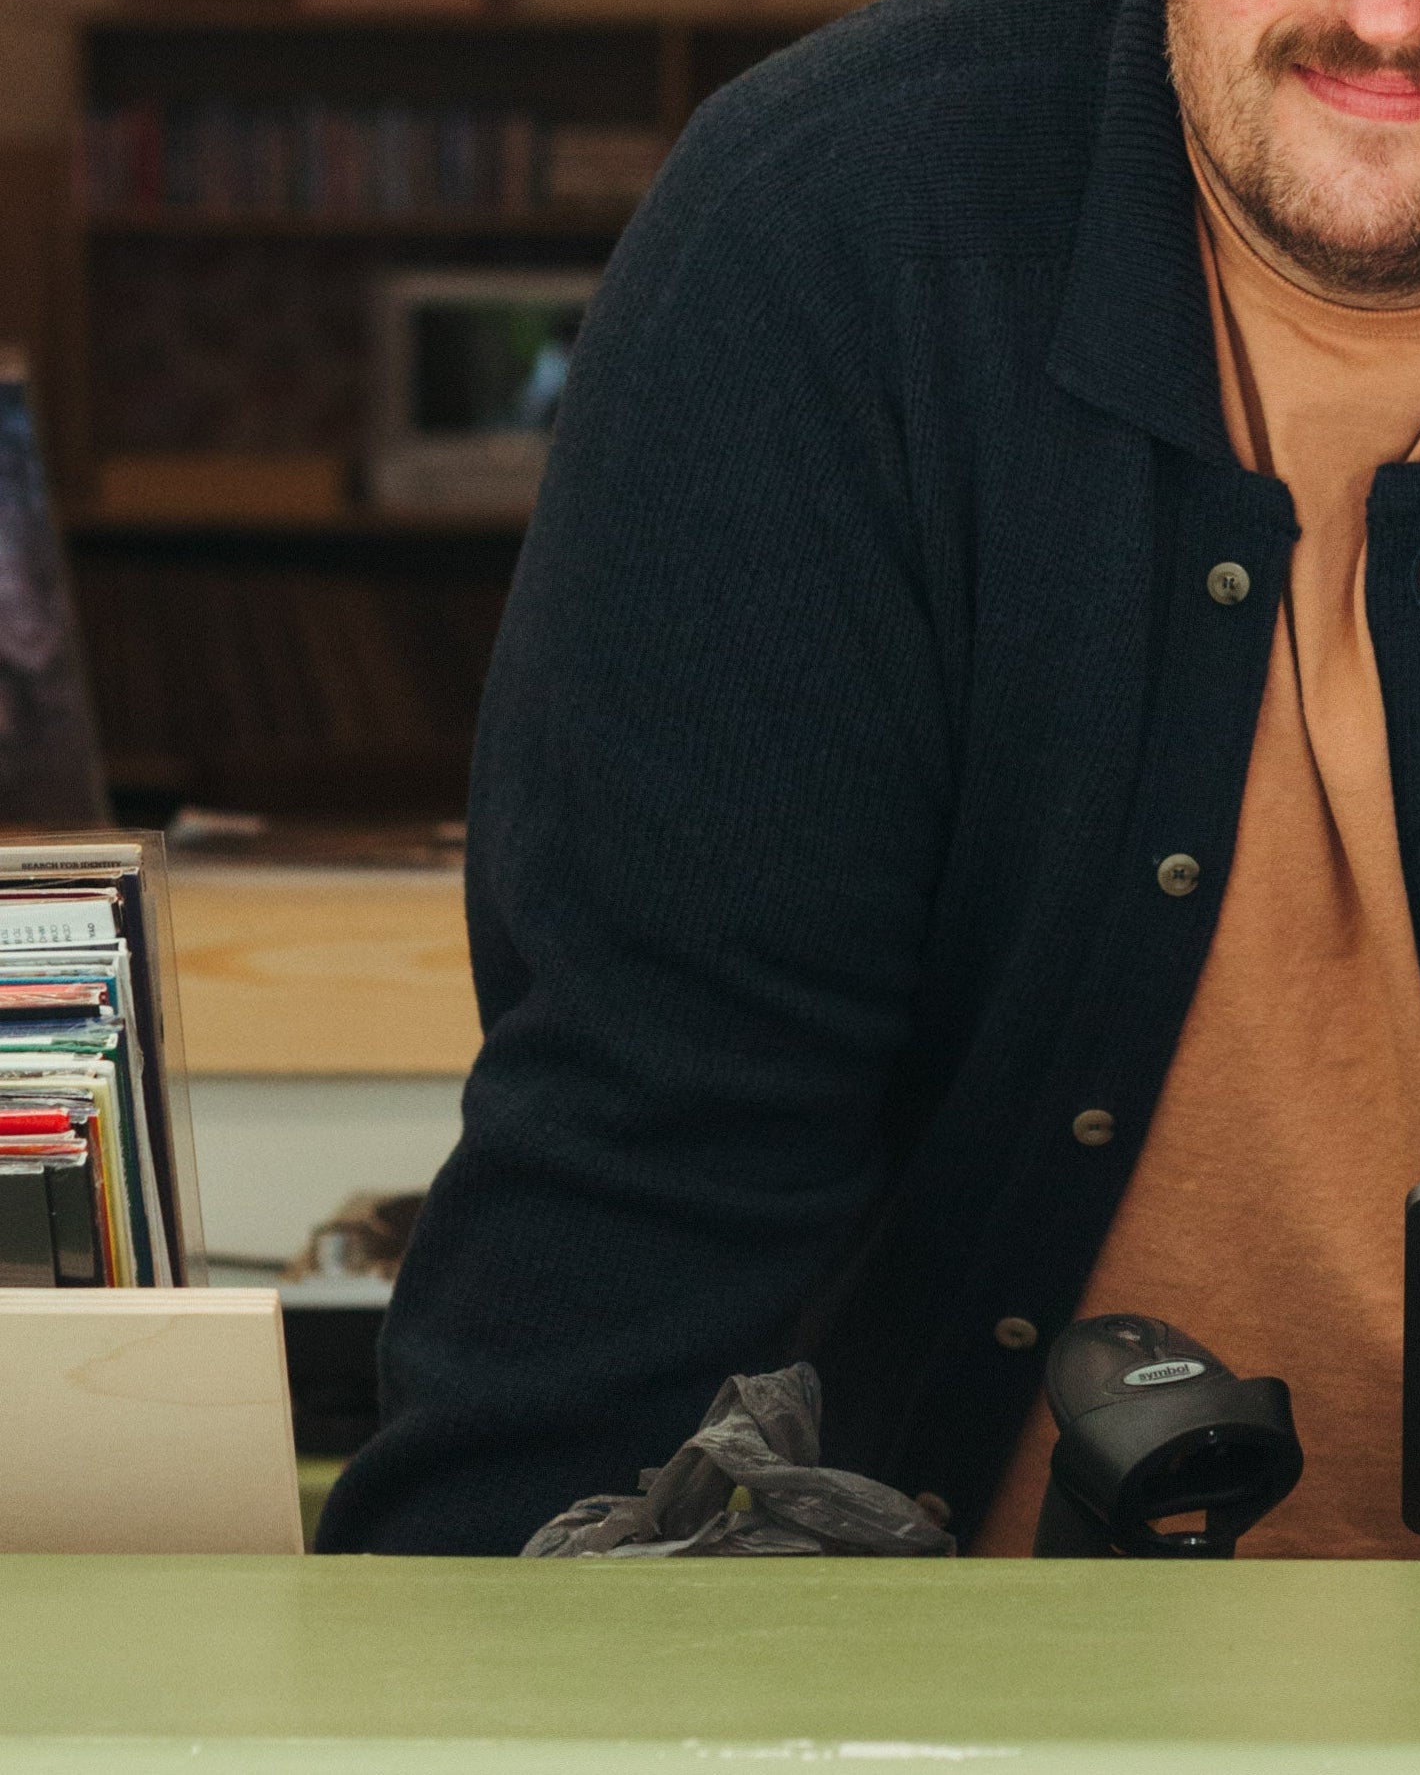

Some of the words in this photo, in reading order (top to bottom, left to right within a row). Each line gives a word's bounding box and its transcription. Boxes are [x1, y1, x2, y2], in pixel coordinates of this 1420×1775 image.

[21, 862, 58, 871] SEARCH
[60, 861, 79, 870] FOR
[80, 860, 122, 869] IDENTITY
[1138, 1363, 1190, 1383] symbol
